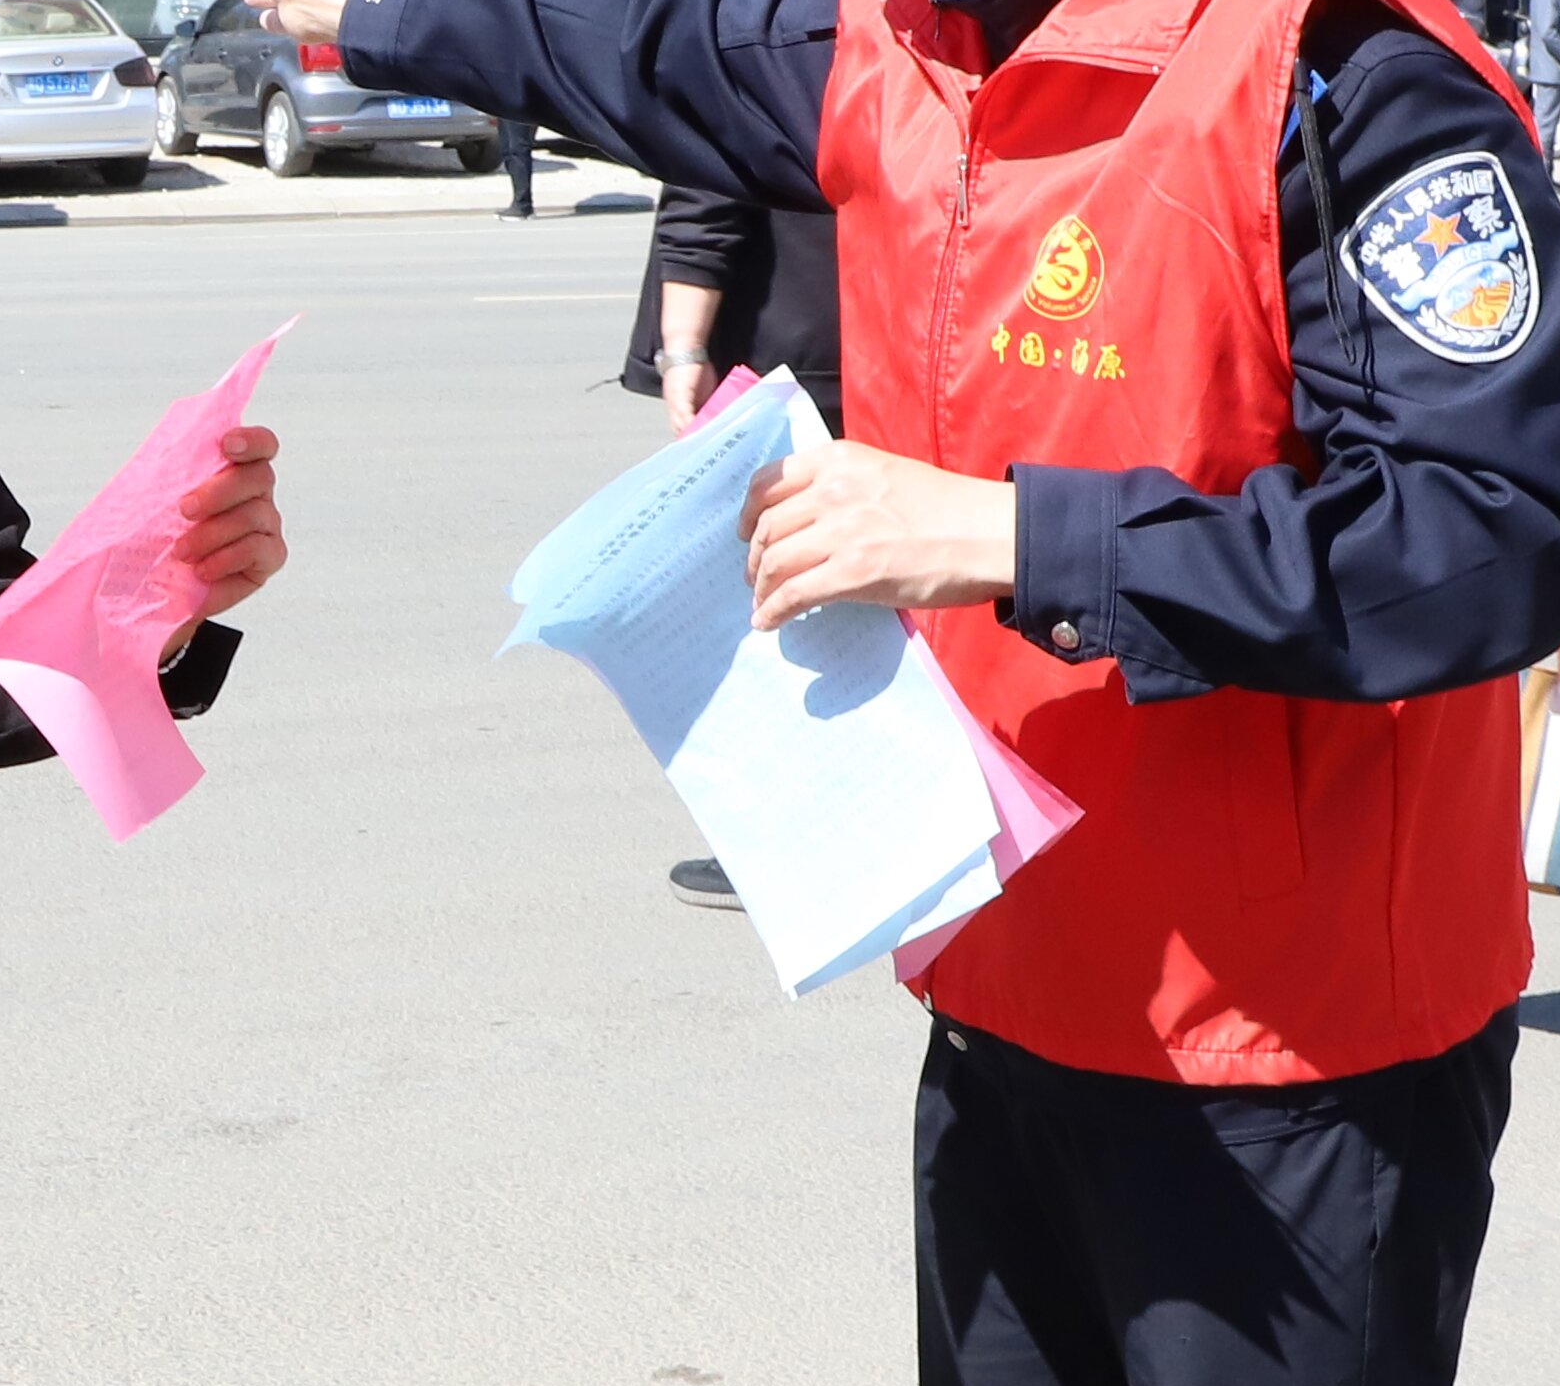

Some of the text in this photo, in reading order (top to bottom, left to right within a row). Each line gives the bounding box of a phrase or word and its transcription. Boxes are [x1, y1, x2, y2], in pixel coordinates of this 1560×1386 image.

[1360, 169, 1496, 266] 中华人民共和国
